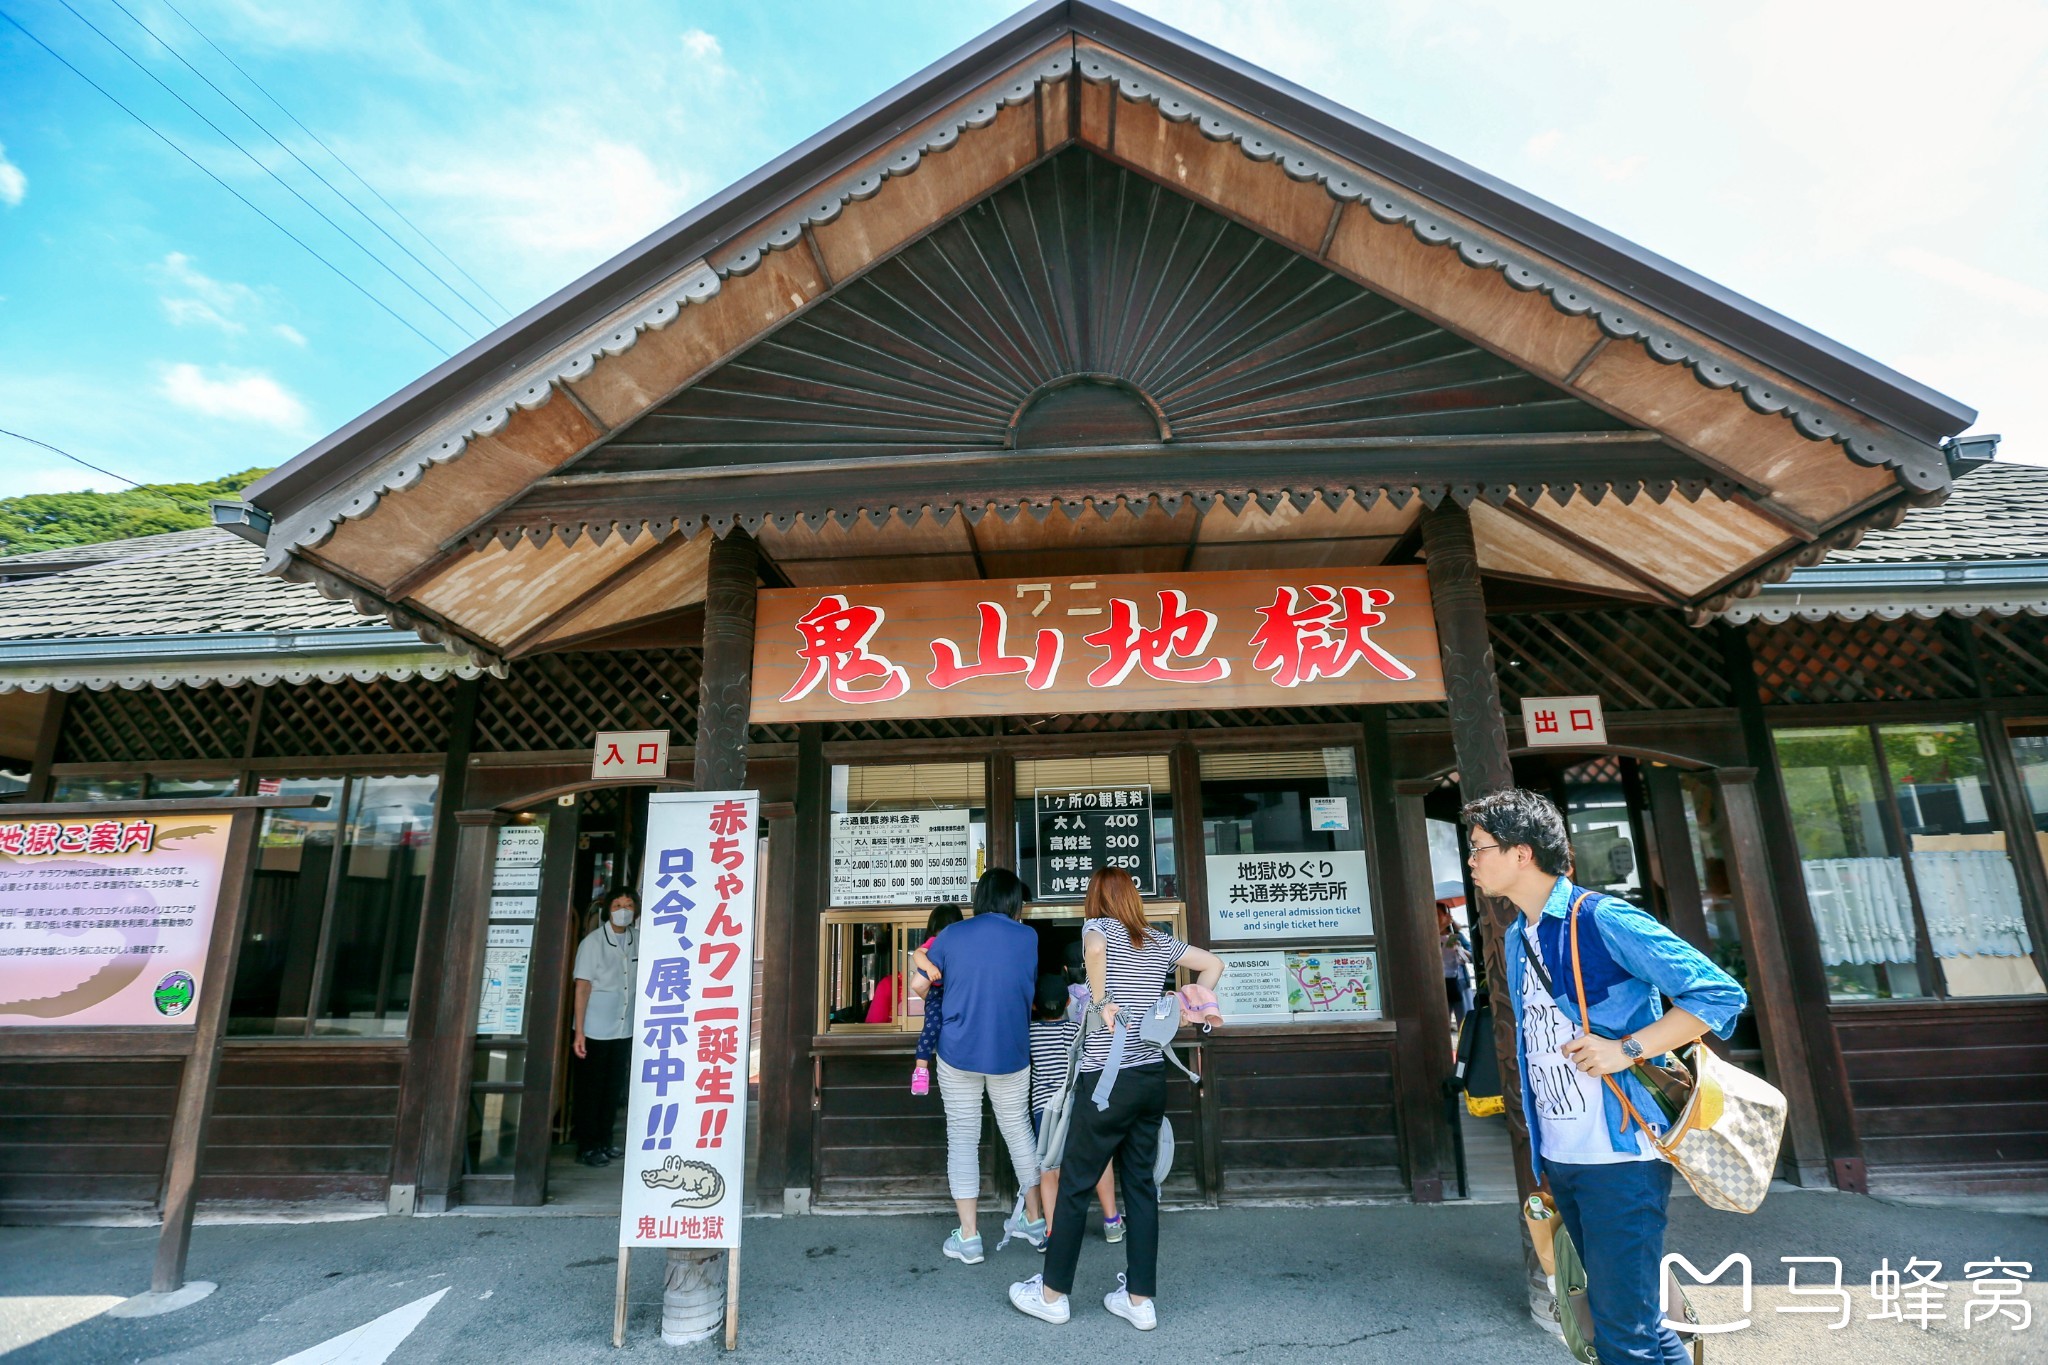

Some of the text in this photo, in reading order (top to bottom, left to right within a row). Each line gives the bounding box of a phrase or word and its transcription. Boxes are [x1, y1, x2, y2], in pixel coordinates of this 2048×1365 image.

[1016, 582, 1096, 617] ワニ
[779, 586, 1416, 704] 鬼山地獄
[1534, 709, 1593, 734] 出口
[602, 743, 659, 766] 入口
[840, 815, 920, 825] 共通観覧券料金表
[1054, 814, 1138, 830] 大人 400
[1049, 835, 1139, 851] 高校生 300
[910, 859, 923, 868] 900
[928, 858, 940, 867] 550
[941, 858, 954, 867] 450
[955, 857, 967, 866] 250
[1050, 855, 1140, 871] 中学生 250
[1237, 860, 1334, 881] 地獄めぐり
[873, 878, 886, 887] 850
[891, 878, 905, 887] 600
[910, 877, 923, 886] 500
[928, 876, 940, 885] 400
[941, 876, 954, 885] 350
[955, 875, 967, 885] 160
[914, 894, 968, 903] 別府地獄組合
[1229, 881, 1347, 904] 共通券発売所
[1219, 906, 1361, 919] We sell general admission ticket
[1243, 919, 1339, 932] and single ticket here
[1228, 960, 1270, 968] ADMISSION
[636, 1215, 725, 1240] 鬼山地獄
